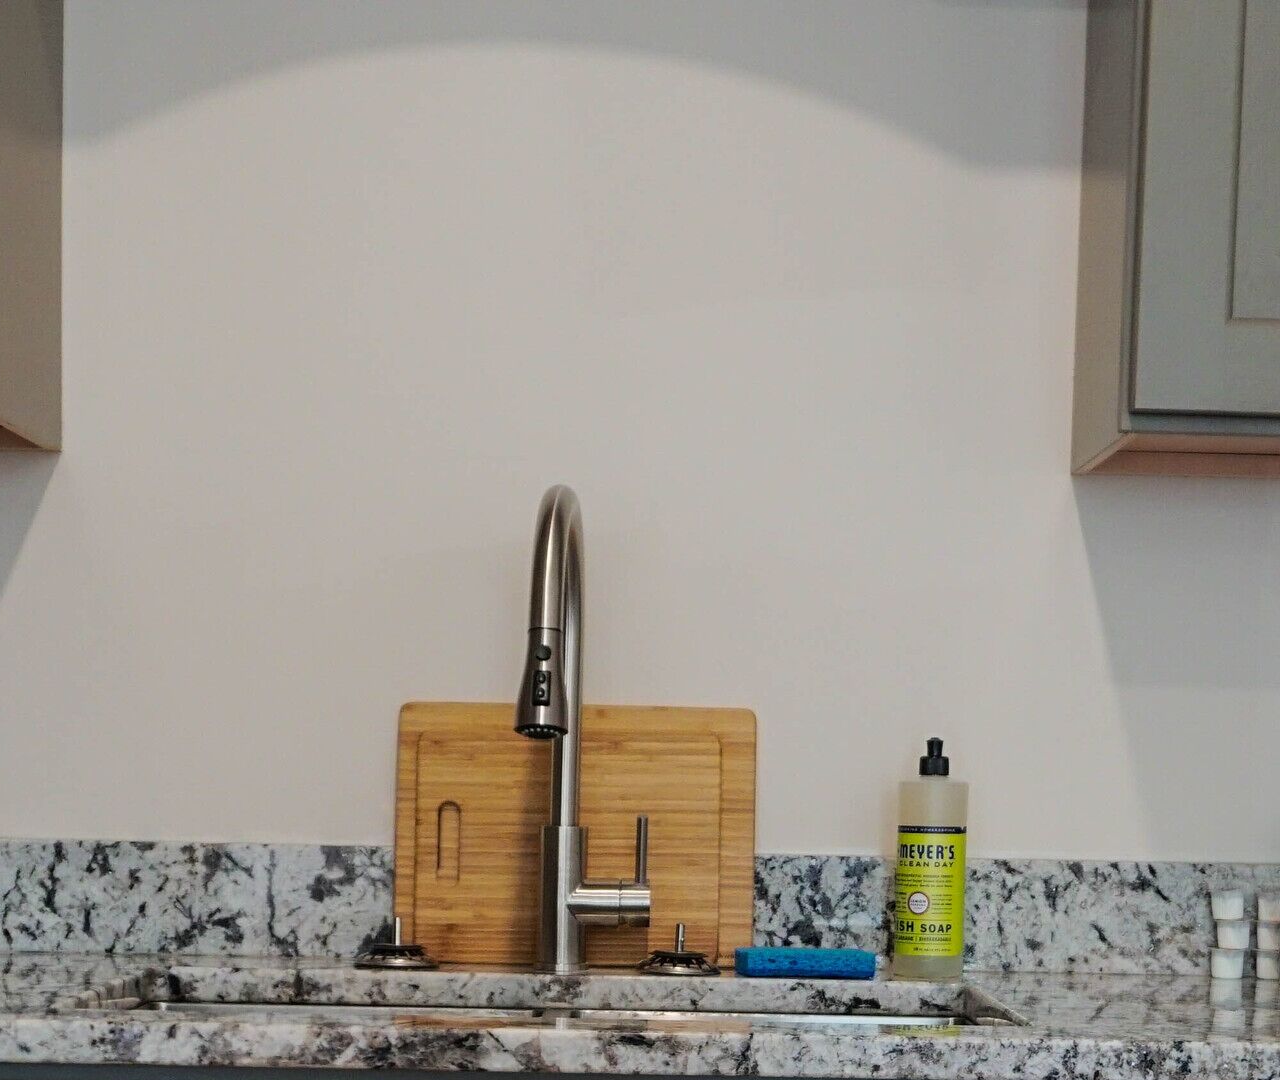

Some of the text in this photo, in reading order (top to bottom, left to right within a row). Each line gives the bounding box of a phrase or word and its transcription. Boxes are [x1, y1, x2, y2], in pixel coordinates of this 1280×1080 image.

[899, 844, 955, 860] MEYER'S
[899, 860, 930, 868] CLEAN
[920, 923, 952, 933] SOAP
